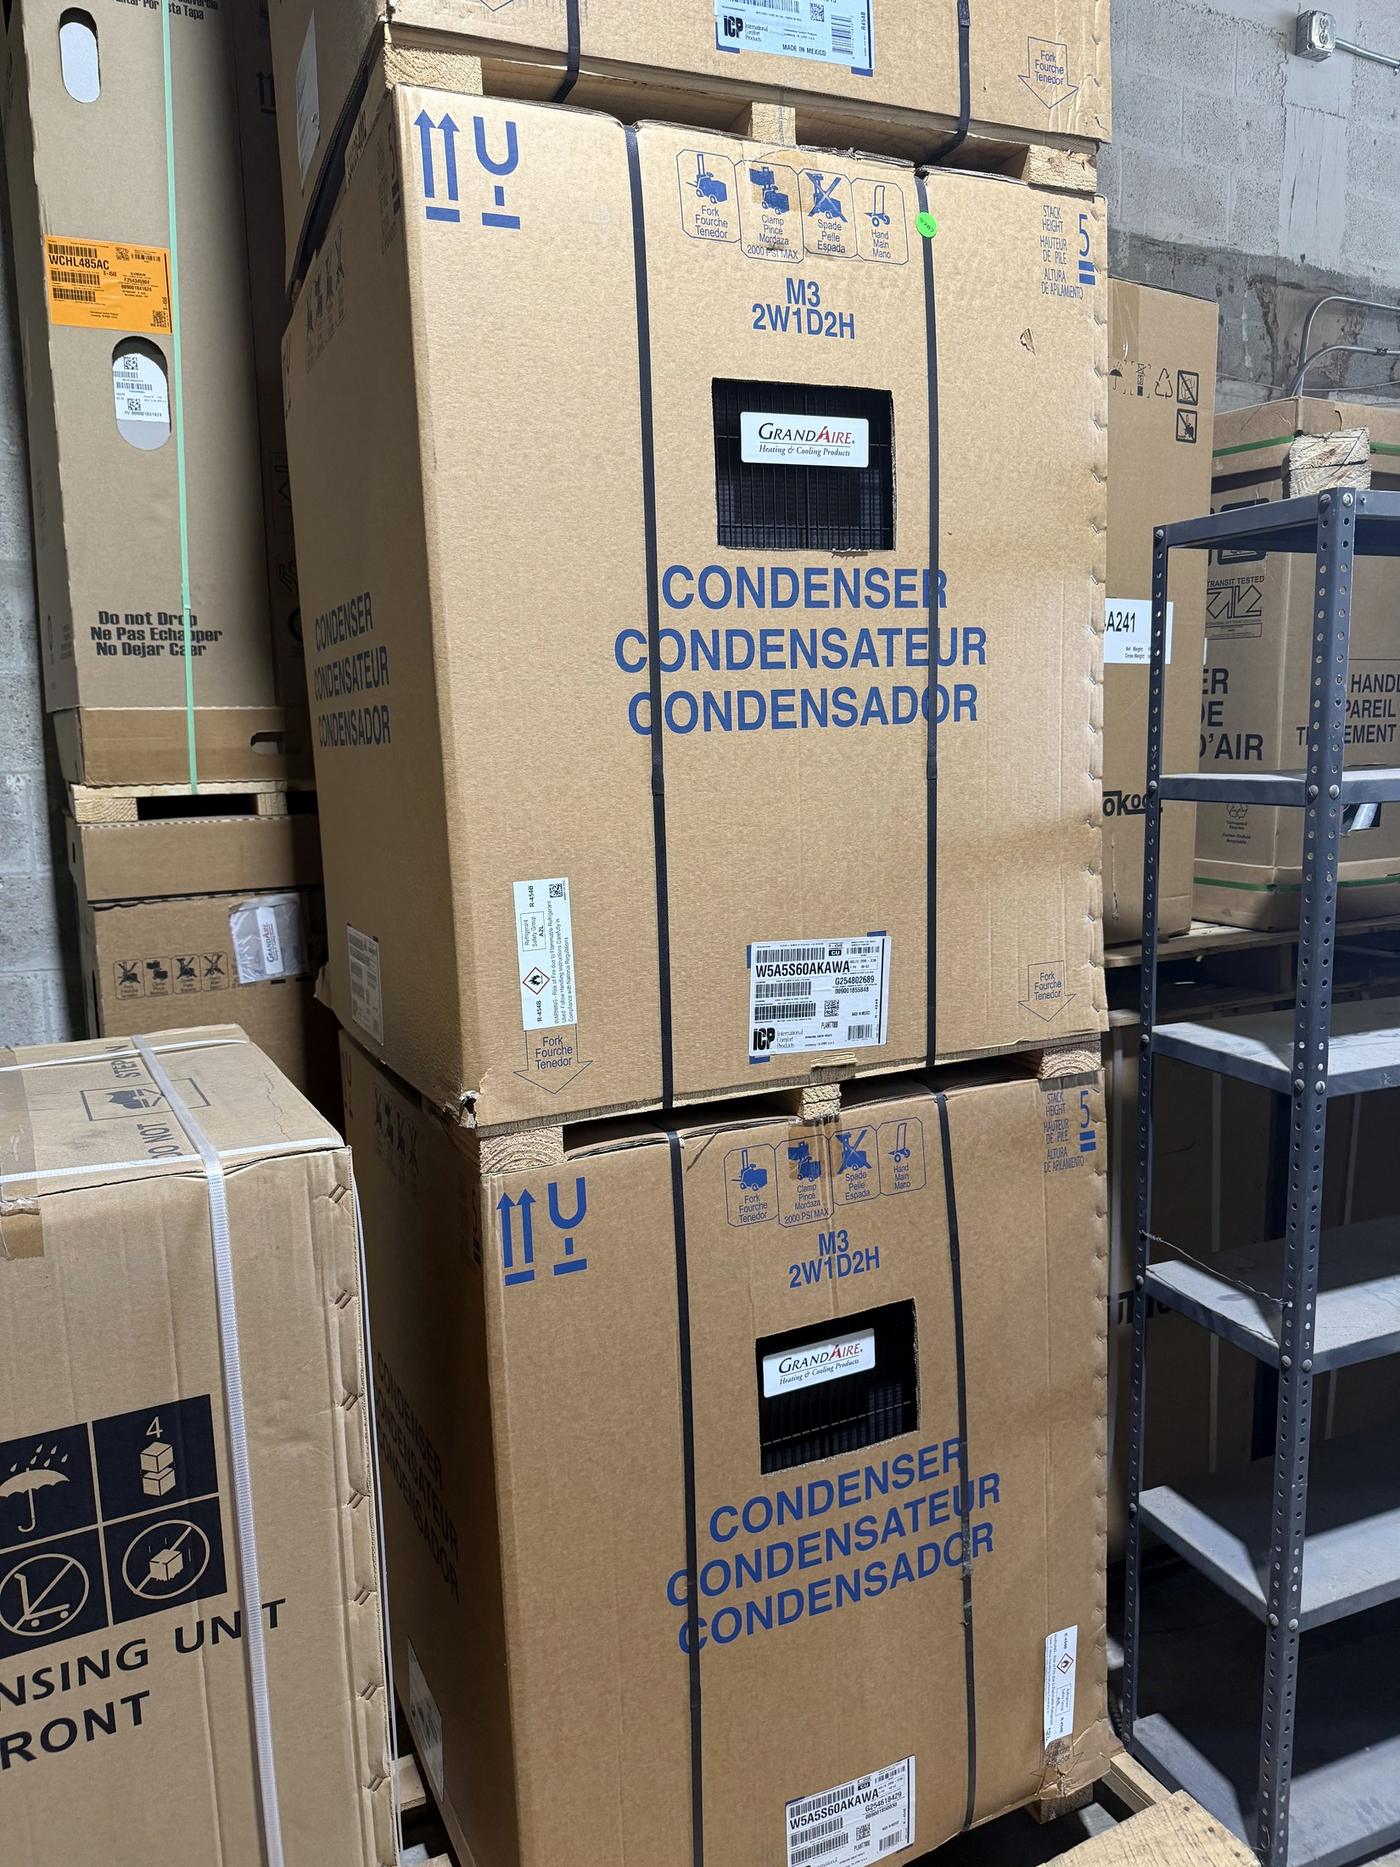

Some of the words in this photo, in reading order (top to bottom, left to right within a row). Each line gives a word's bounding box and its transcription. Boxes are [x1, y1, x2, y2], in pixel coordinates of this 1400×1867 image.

[183, 6, 204, 20] Tapa
[782, 43, 797, 52] MADE
[806, 46, 827, 57] MEXICO
[1040, 50, 1056, 63] Fork
[1035, 59, 1064, 74] Fourche
[1034, 70, 1064, 85] Tenedor
[701, 205, 720, 216] Fork
[1043, 205, 1061, 219] STACK
[695, 214, 728, 228] Fourche
[761, 214, 784, 226] Clamp
[818, 219, 842, 231] Spade
[1042, 219, 1063, 233] HEIGHT
[695, 225, 728, 239] Tenedor
[763, 224, 783, 235] Pince
[871, 229, 889, 240] Hand
[1079, 213, 1090, 257] 5
[759, 233, 789, 245] Mordaza
[821, 231, 840, 243] Pelle
[873, 239, 890, 249] Main
[1040, 235, 1067, 251] HAUTEUR
[747, 244, 765, 256] 2000
[817, 240, 846, 254] Espada
[872, 248, 891, 259] Mano
[48, 254, 110, 271] WCHL485AC
[1044, 268, 1066, 283] ALTURA
[786, 277, 821, 308] M3
[751, 303, 855, 340] 2W1D2H
[759, 444, 786, 456] Heating
[787, 446, 795, 454] &
[796, 446, 821, 457] Cooling
[823, 448, 850, 457] Products
[662, 564, 948, 610] CONDENSER
[1237, 575, 1265, 585] TESTED
[98, 611, 120, 625] Do
[124, 611, 153, 625] not
[315, 591, 374, 652] CONDENSER
[90, 627, 112, 640] Ne
[116, 627, 146, 641] Pas
[96, 642, 118, 656] No
[122, 642, 165, 658] Dejar
[614, 626, 988, 674] CONDENSATEUR
[314, 645, 390, 702] CONDENSATEUR
[628, 683, 978, 736] CONDENSADOR
[318, 704, 391, 748] CONDENSADOR
[755, 960, 851, 978] W5A5S60AKAWA
[1040, 971, 1055, 981] Fork
[1035, 980, 1062, 990] Fourche
[1034, 990, 1061, 1000] Tenedor
[542, 1035, 563, 1047] Fork
[535, 1045, 573, 1058] Fourche
[535, 1057, 572, 1070] Tenedor
[1047, 1091, 1064, 1105] STACK
[1045, 1103, 1066, 1116] HEIGHT
[1081, 1090, 1091, 1128] 5
[137, 1122, 175, 1144] NOT
[893, 1163, 909, 1173] Hand
[845, 1171, 867, 1182] Spade
[894, 1173, 910, 1181] Main
[797, 1184, 816, 1193] Clamp
[894, 1181, 911, 1190] Mano
[744, 1195, 760, 1204] Fork
[798, 1193, 816, 1201] Pince
[845, 1189, 870, 1200] Espada
[739, 1202, 768, 1214] Fourche
[794, 1199, 821, 1210] Mordaza
[739, 1211, 768, 1223] Tenedor
[784, 1213, 800, 1224] 2000
[801, 1210, 814, 1220] PSI
[814, 1207, 829, 1218] MAX
[818, 1229, 850, 1257] M3
[789, 1246, 880, 1288] 2W1D2H
[779, 1372, 803, 1385] Heating
[804, 1371, 811, 1379] &
[811, 1365, 834, 1377] Cooling
[835, 1358, 860, 1371] Products
[146, 1415, 164, 1439] 4
[709, 1437, 963, 1543] CONDENSER
[666, 1472, 1001, 1607] CONDENSATEUR
[678, 1521, 995, 1655] CONDENSADOR
[174, 1599, 286, 1654] UNT
[790, 1788, 879, 1830] W5A5S60AKAWA
